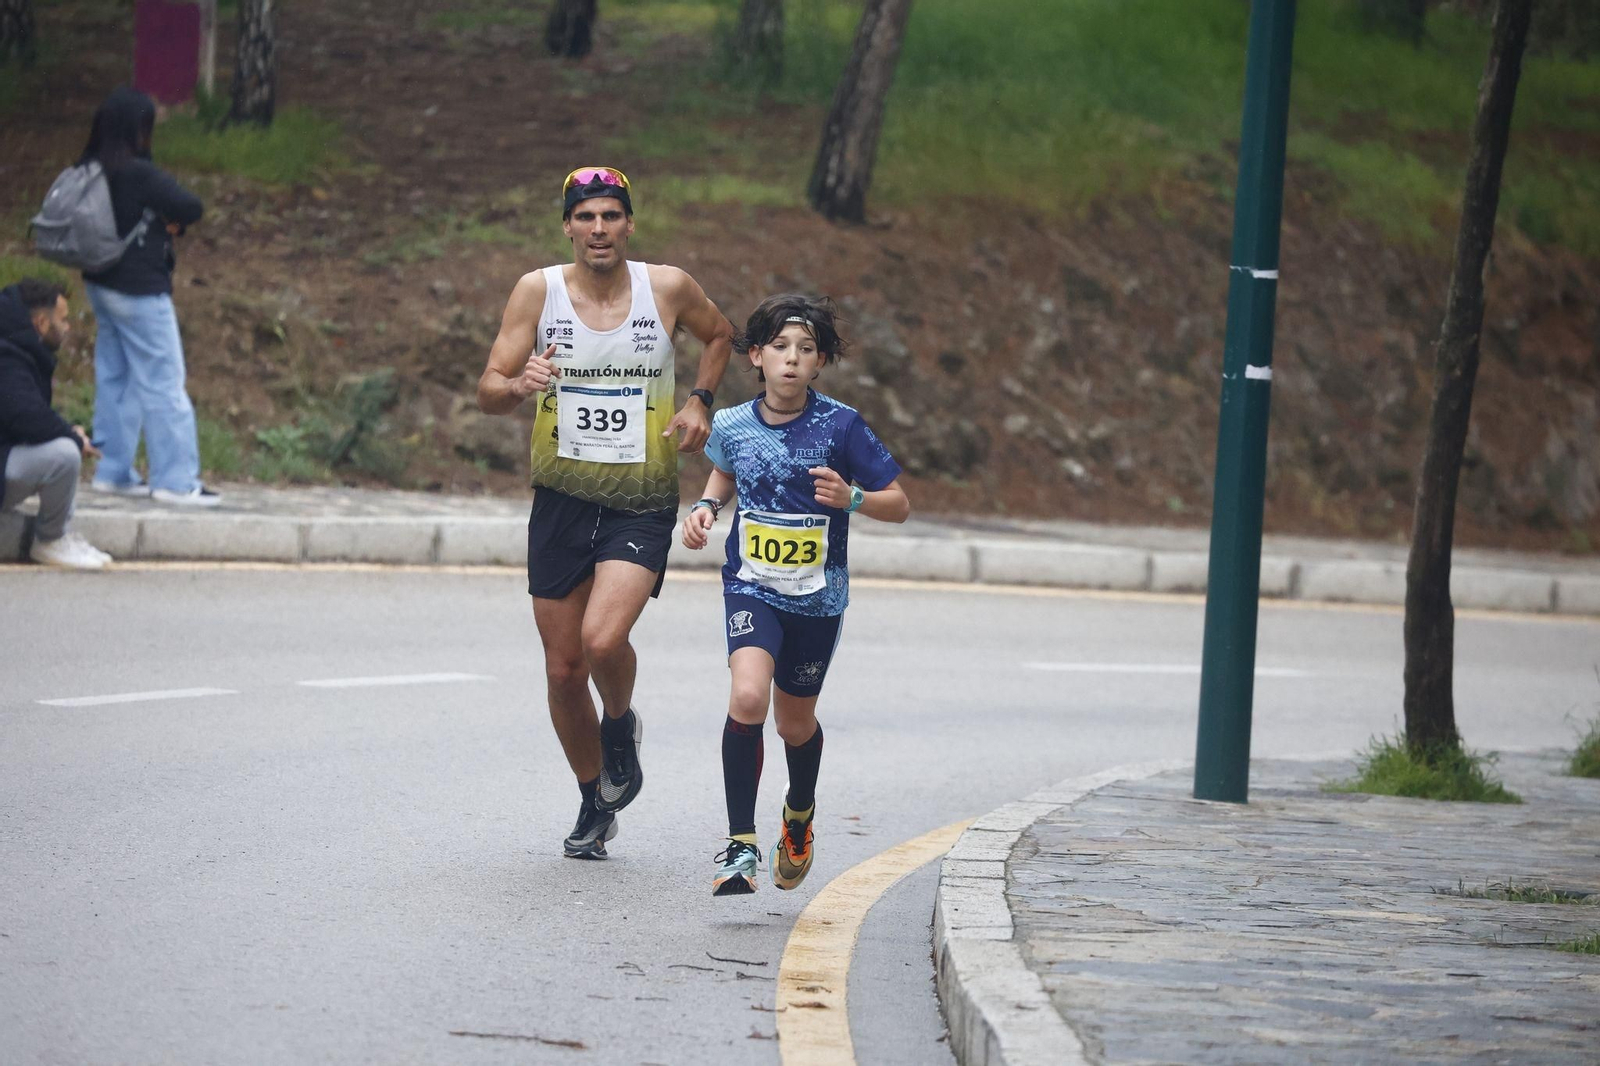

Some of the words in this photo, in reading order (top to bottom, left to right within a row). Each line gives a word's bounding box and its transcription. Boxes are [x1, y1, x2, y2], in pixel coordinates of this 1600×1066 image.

[632, 316, 656, 329] víve
[546, 327, 573, 339] gross
[564, 364, 621, 377] TRIATLÓN
[576, 407, 628, 433] 339
[796, 446, 831, 459] nerja
[750, 534, 817, 565] 1023
